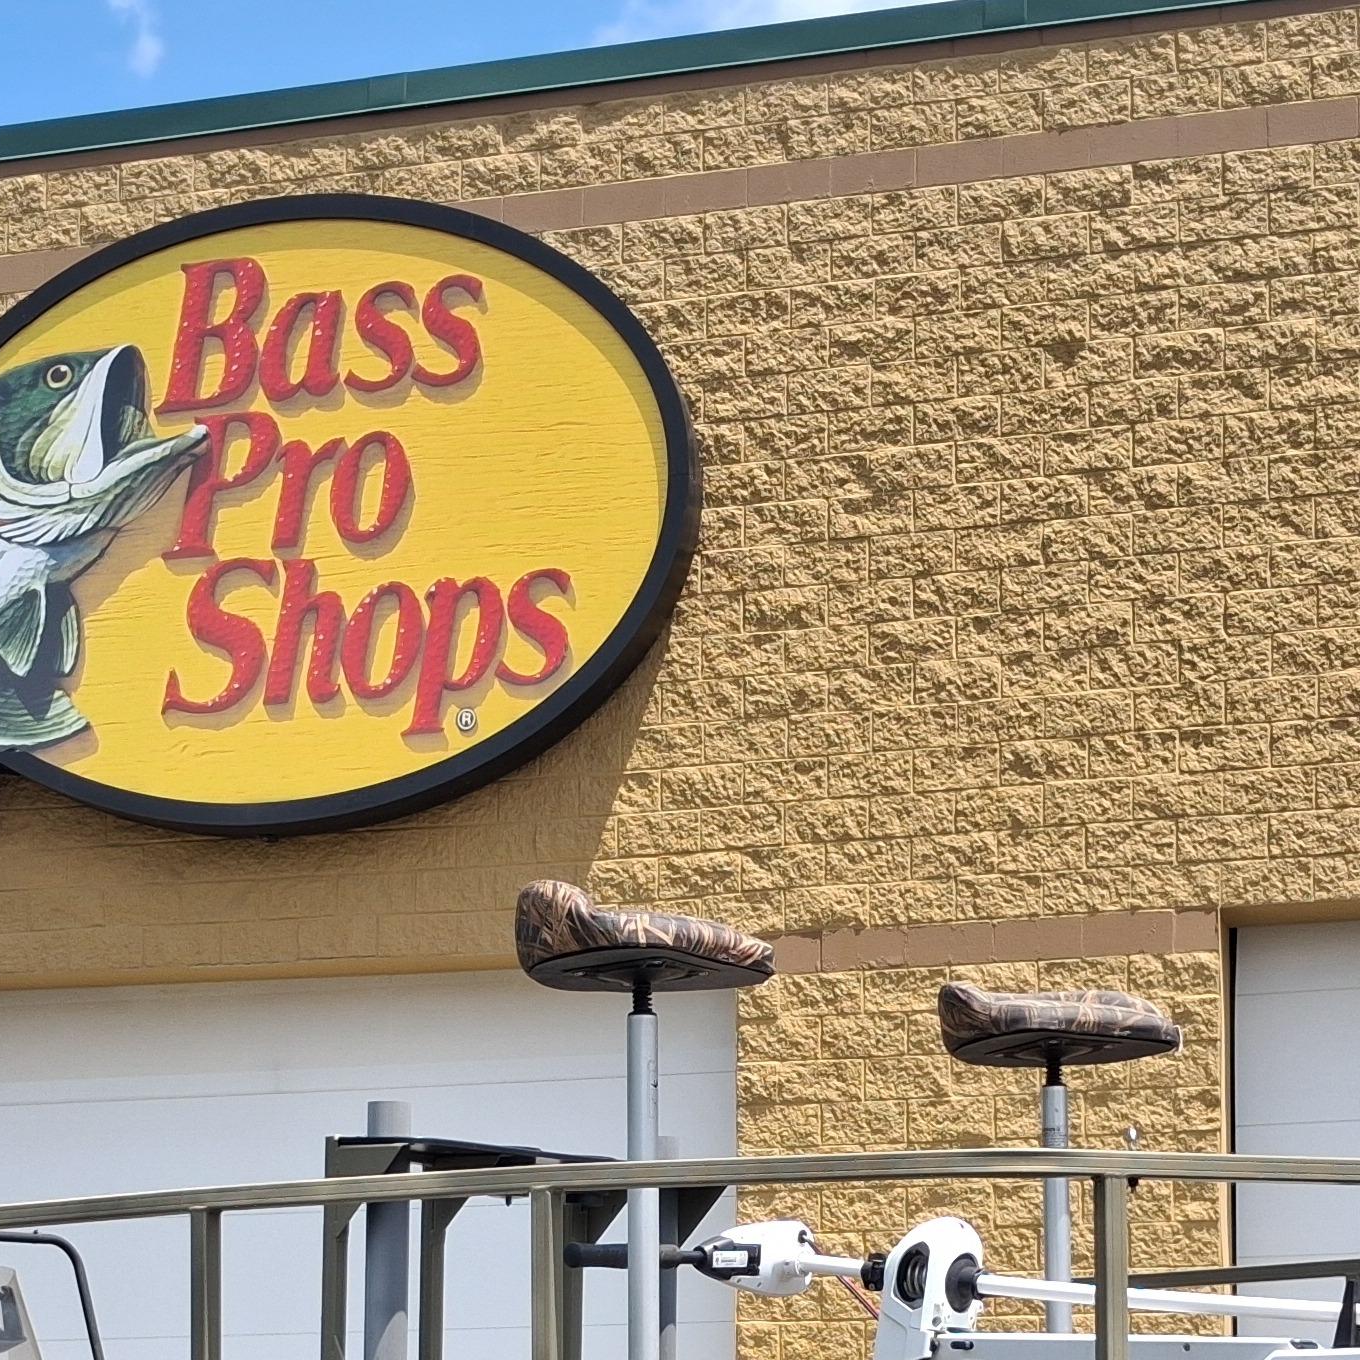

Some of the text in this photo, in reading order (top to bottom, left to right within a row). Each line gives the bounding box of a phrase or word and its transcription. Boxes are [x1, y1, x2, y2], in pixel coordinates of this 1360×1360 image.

[155, 257, 482, 415] Bass
[162, 411, 412, 560] Pro
[161, 558, 571, 736] Shops
